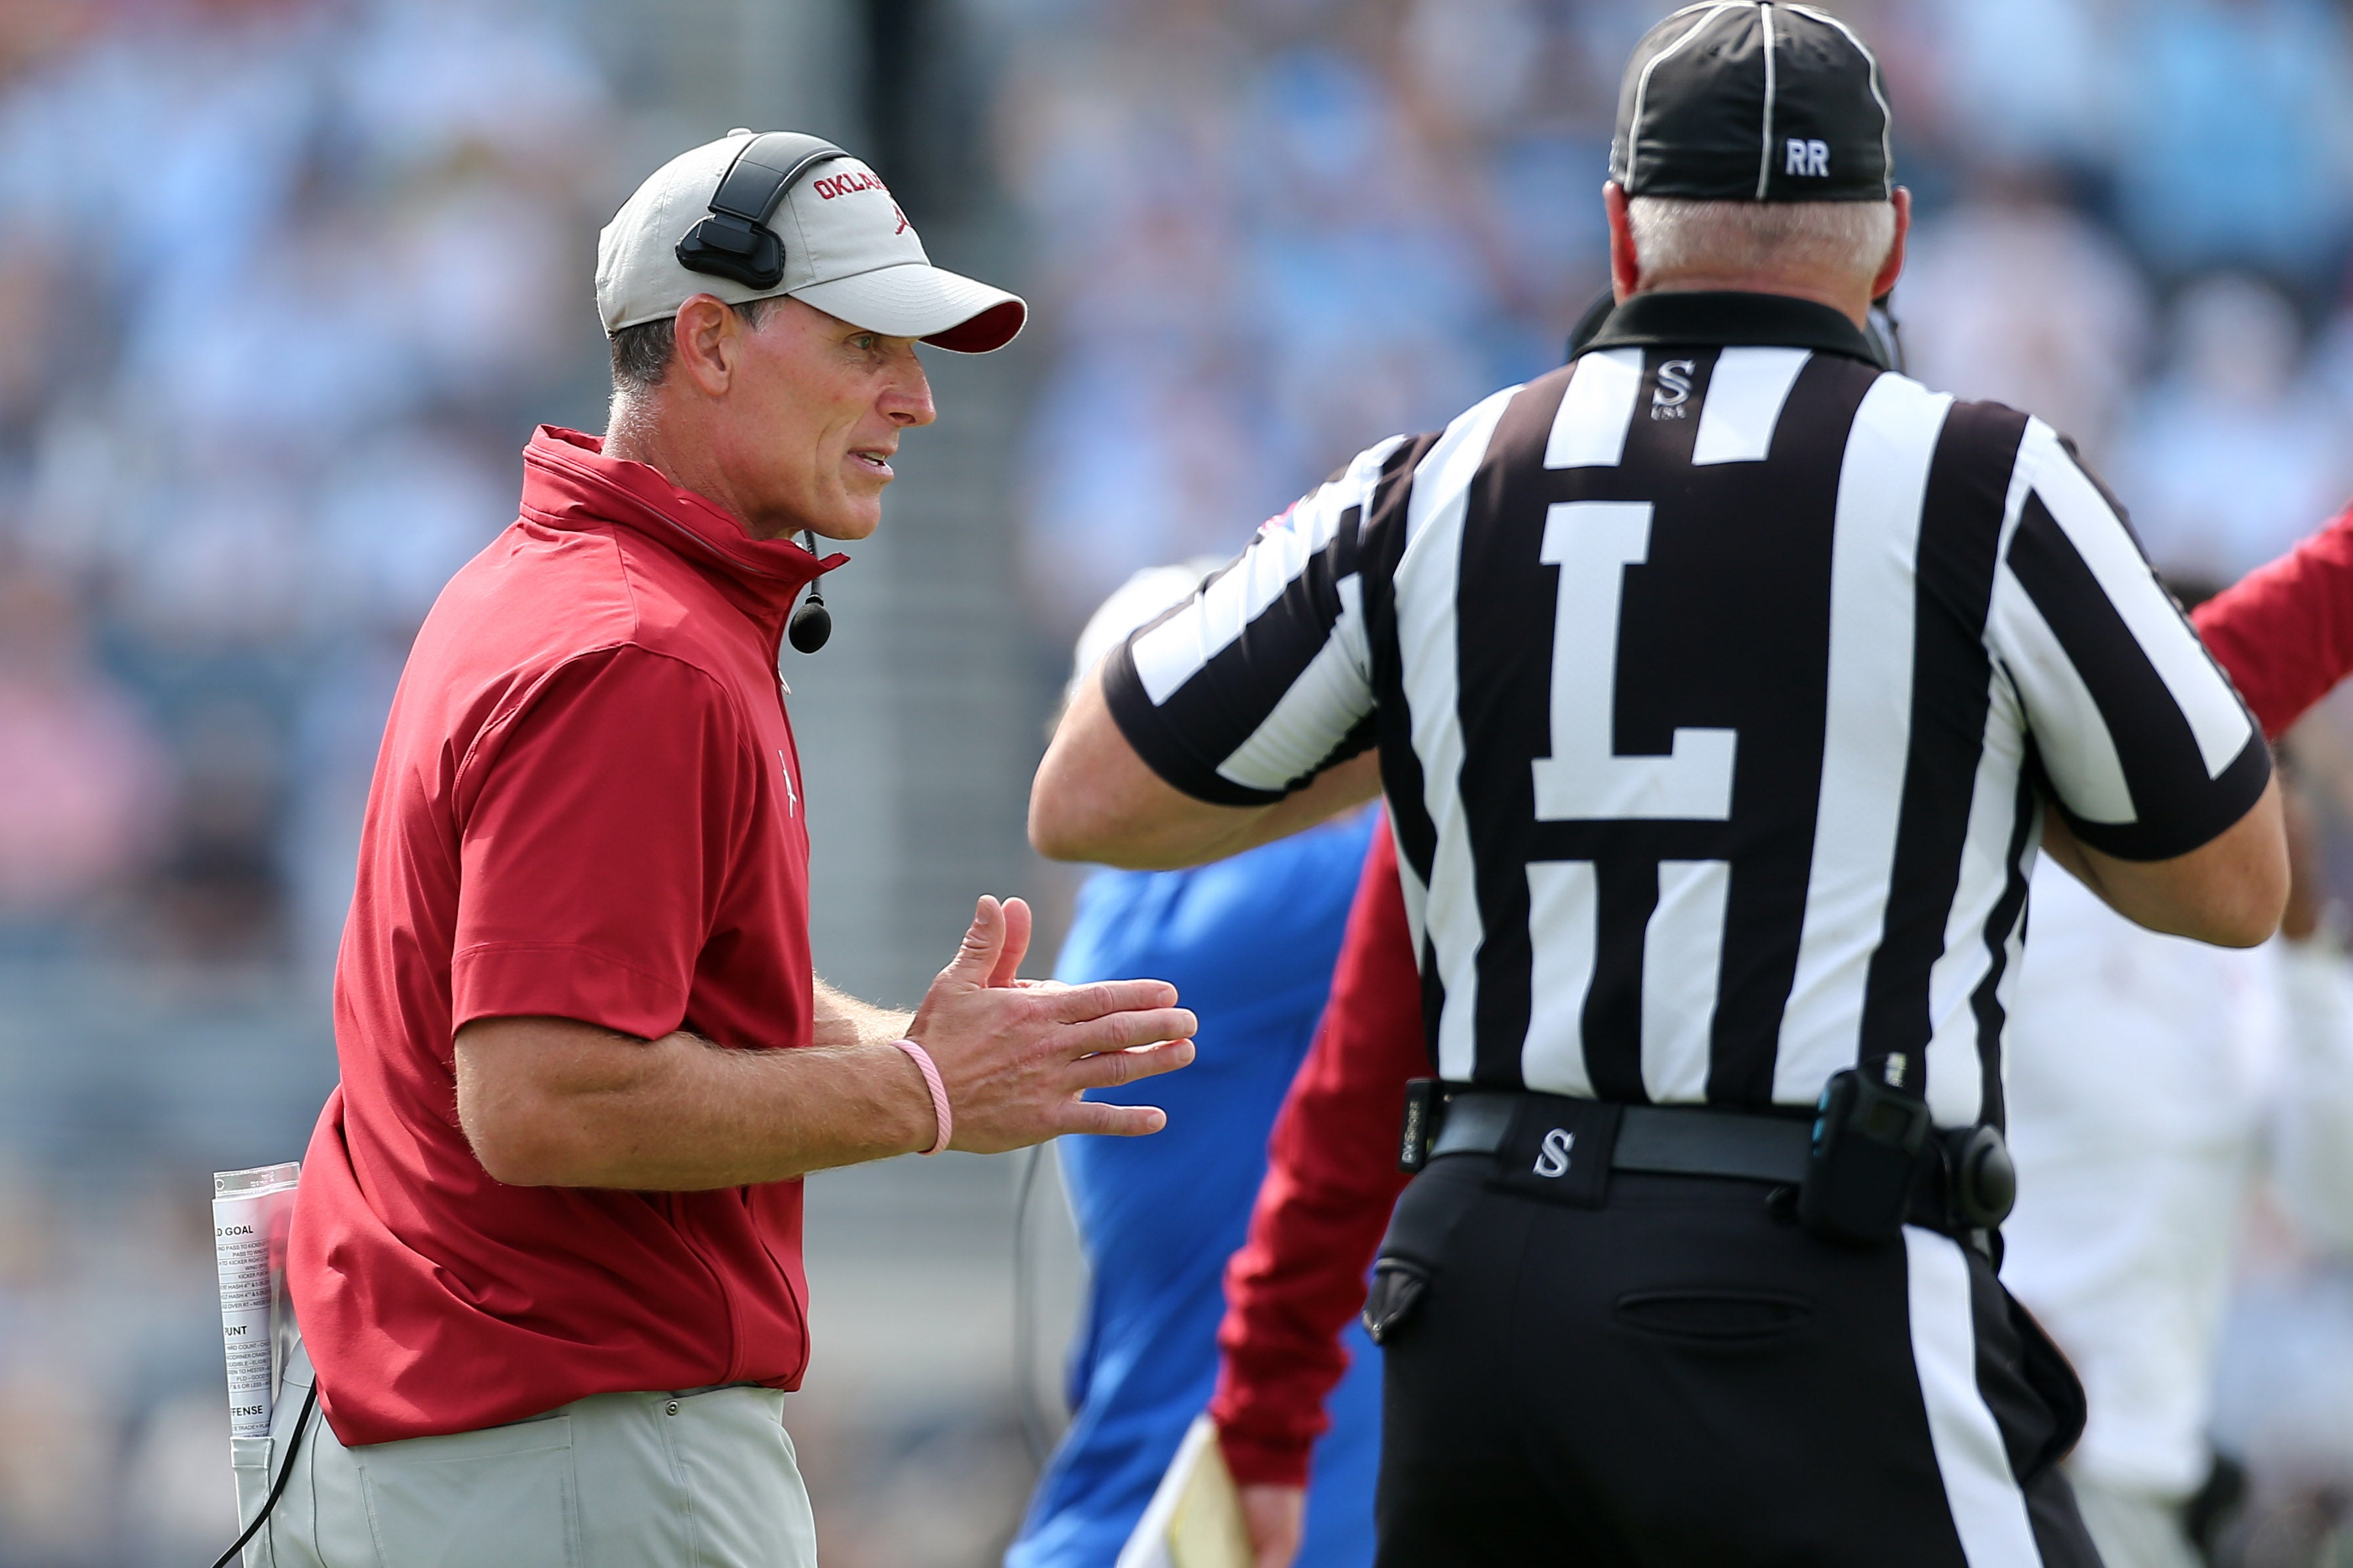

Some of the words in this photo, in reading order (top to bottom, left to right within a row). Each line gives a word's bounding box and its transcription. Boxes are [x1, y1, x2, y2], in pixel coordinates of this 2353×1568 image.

[1785, 137, 1830, 178] RR
[1531, 500, 1738, 822] L
[1532, 1127, 1576, 1177] S
[225, 1225, 254, 1236] GOAL
